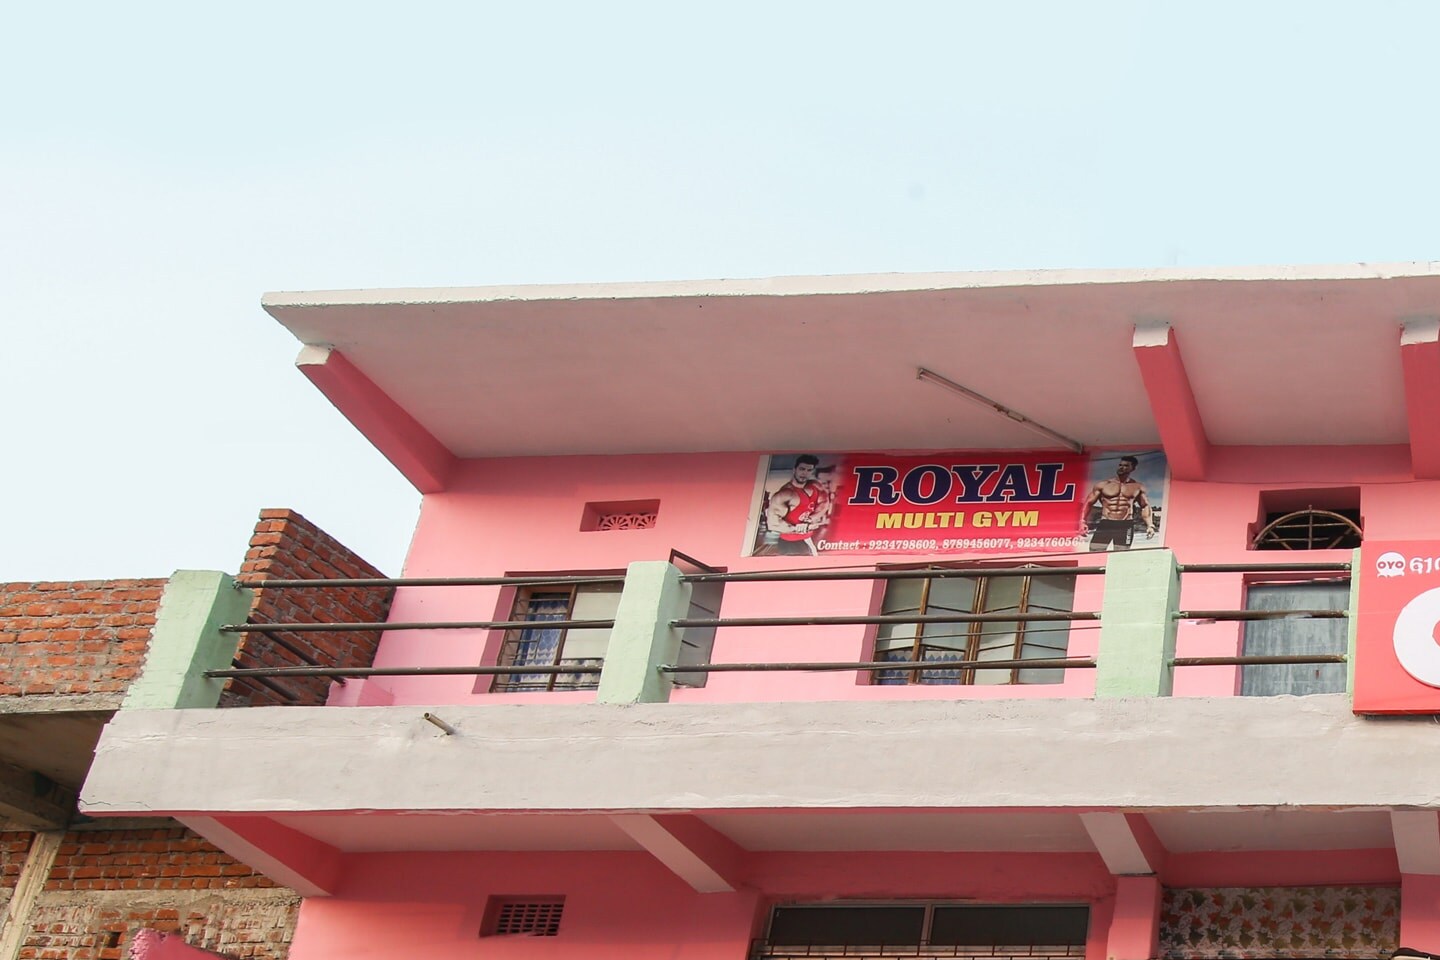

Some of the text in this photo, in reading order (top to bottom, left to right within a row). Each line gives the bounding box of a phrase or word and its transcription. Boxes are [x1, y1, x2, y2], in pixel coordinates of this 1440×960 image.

[848, 463, 1075, 505] ROYAL
[876, 510, 1038, 529] MULTI GYM
[817, 539, 860, 550] Contact
